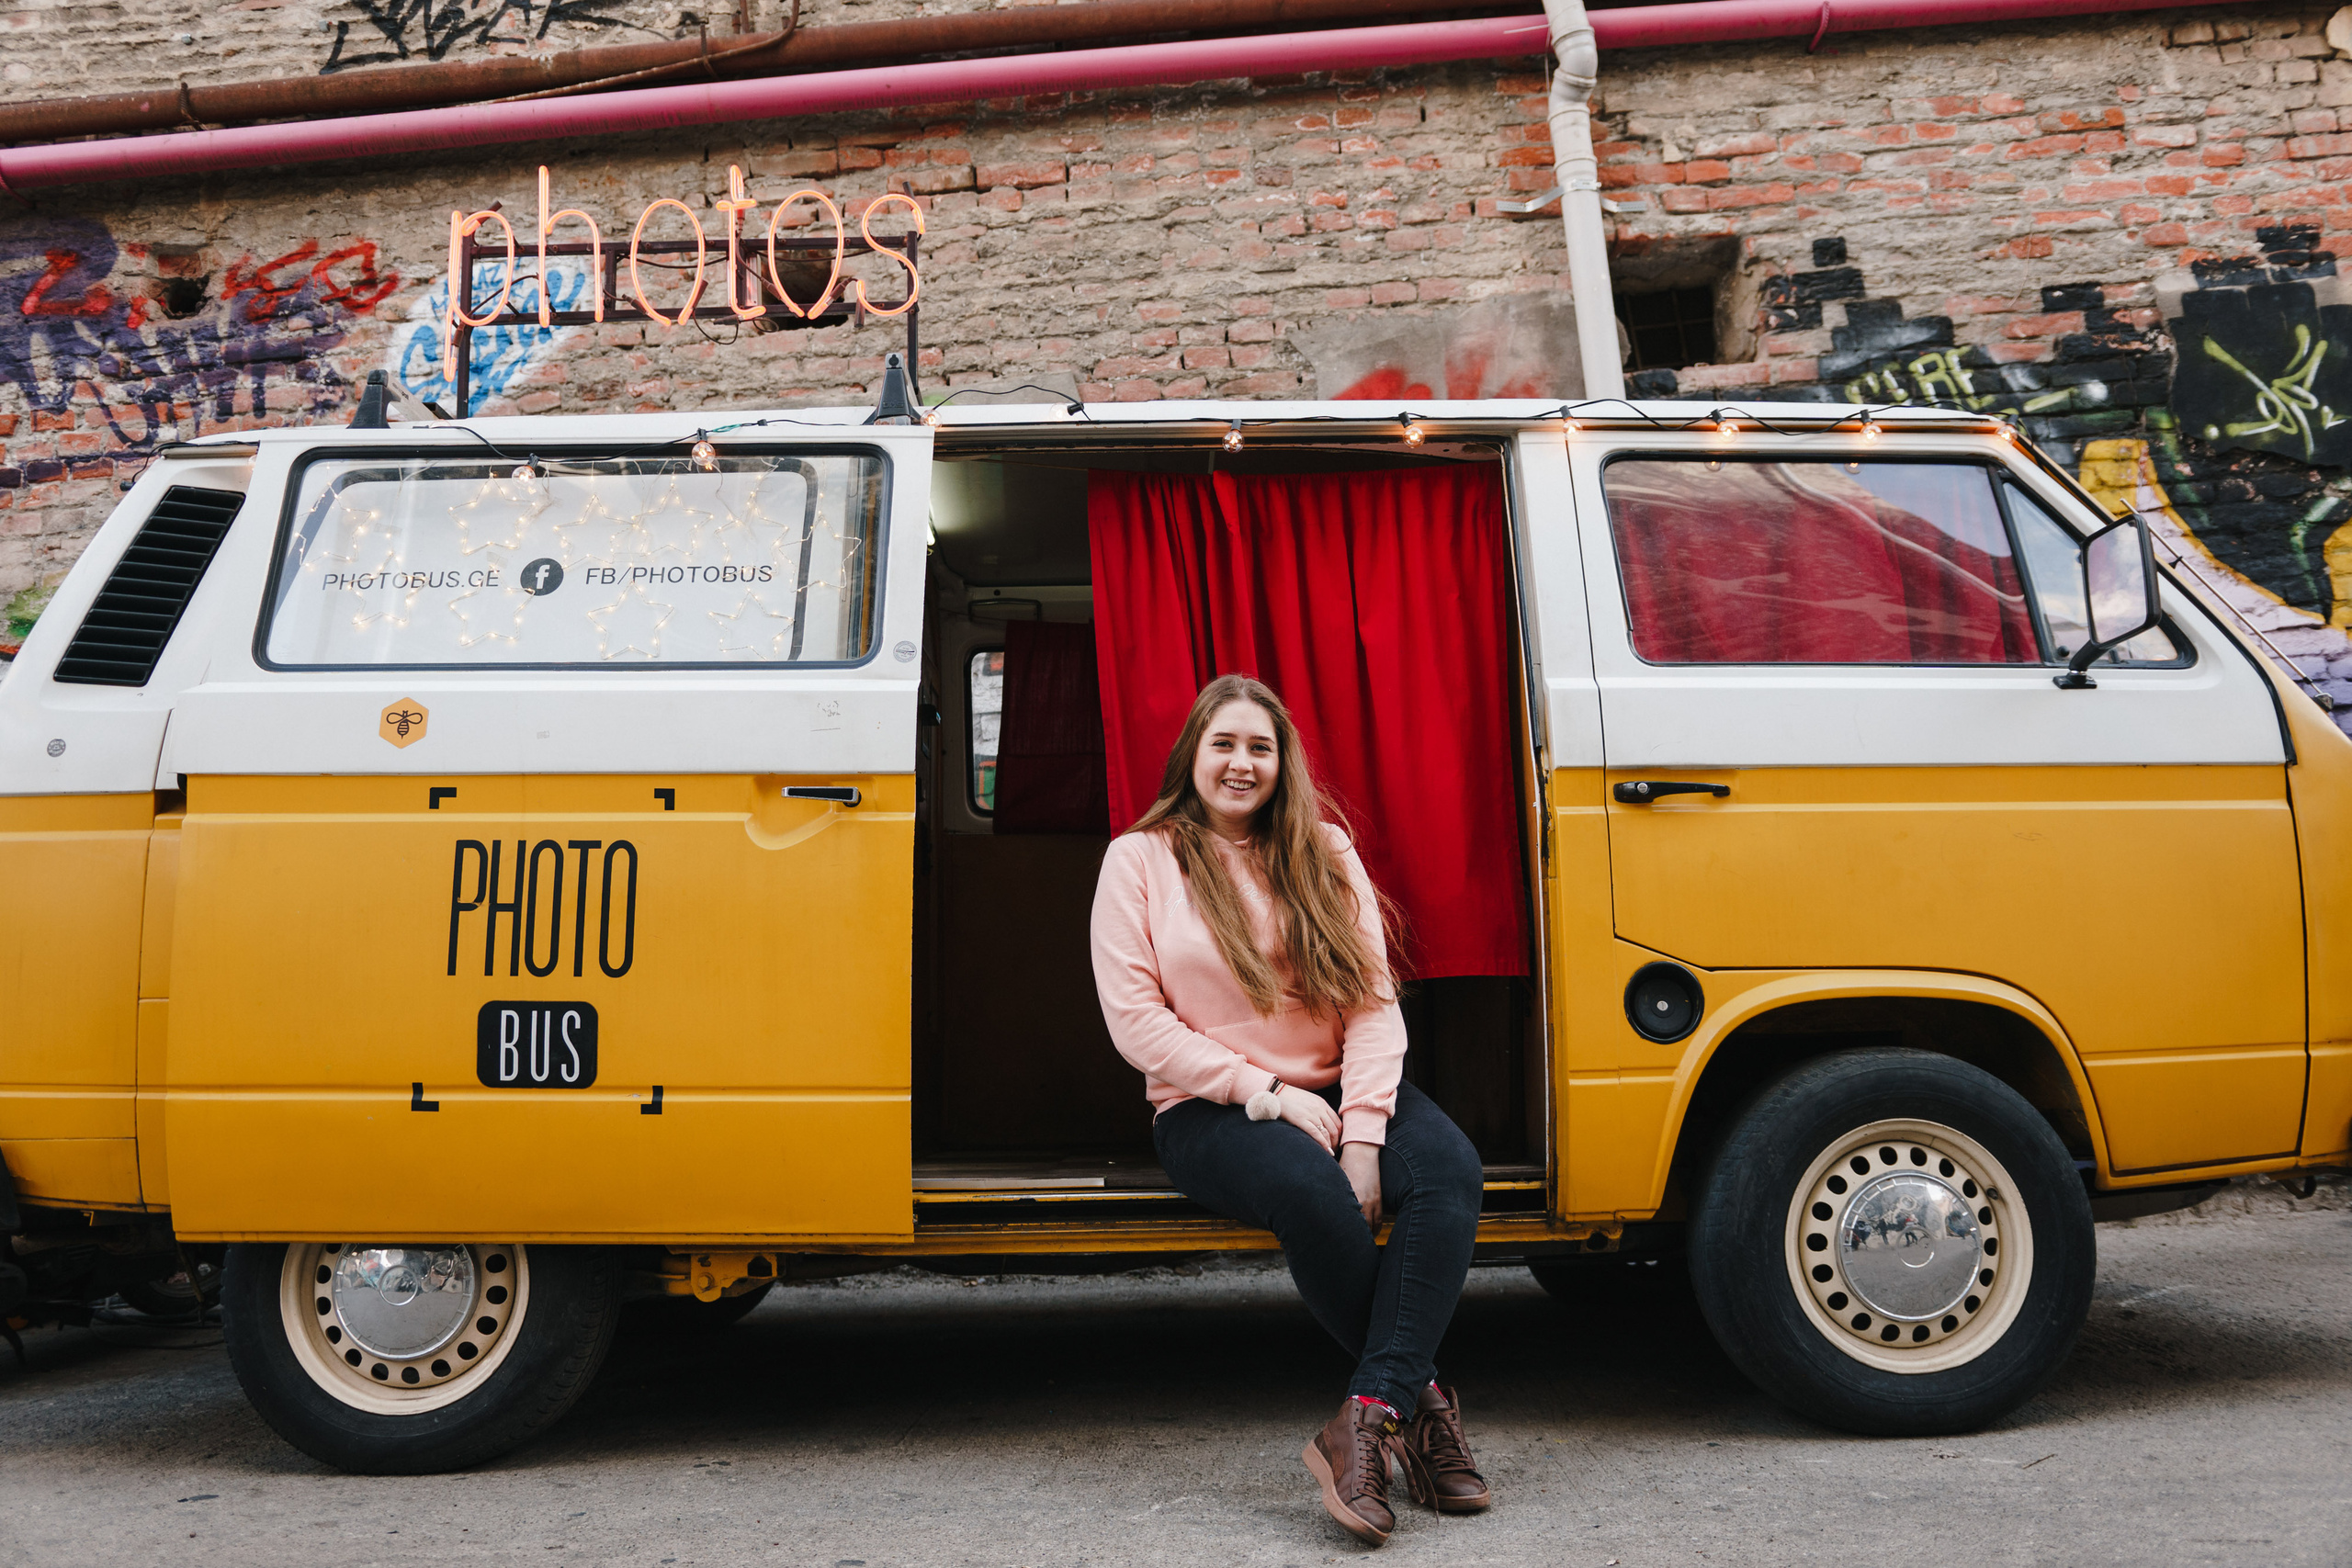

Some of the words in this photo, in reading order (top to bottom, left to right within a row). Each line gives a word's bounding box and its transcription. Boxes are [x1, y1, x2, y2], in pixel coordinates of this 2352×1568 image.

[444, 164, 926, 383] photos
[322, 570, 500, 591] PHOTOBUS.GE
[585, 565, 774, 585] FB/PHOTOBUS
[447, 839, 639, 978] PHOTO
[499, 1010, 582, 1083] BUS
